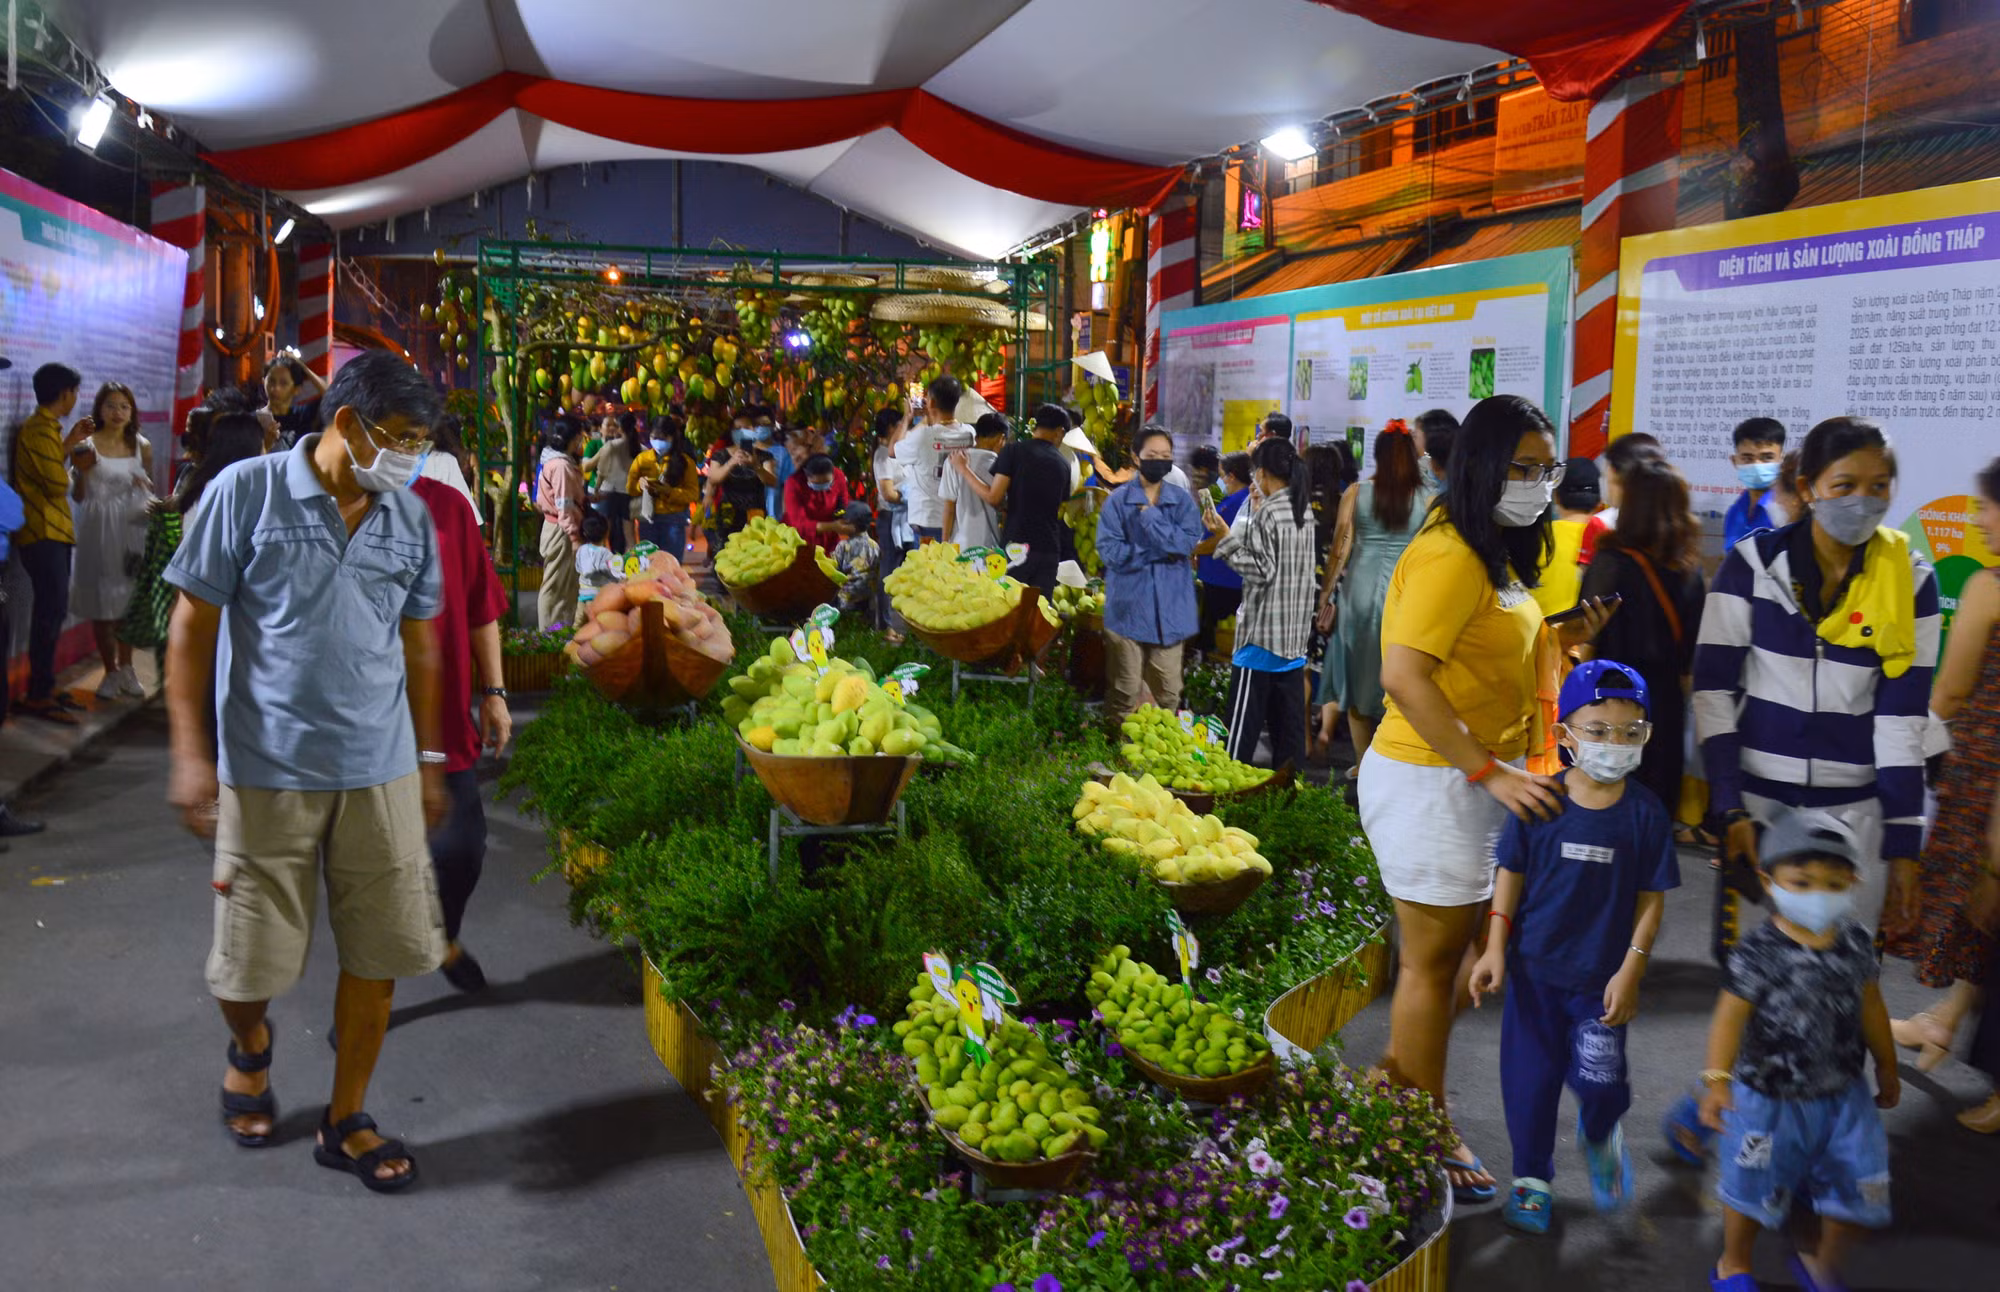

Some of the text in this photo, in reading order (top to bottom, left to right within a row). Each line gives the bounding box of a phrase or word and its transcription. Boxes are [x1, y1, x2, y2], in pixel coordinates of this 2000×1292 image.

[1718, 223, 1985, 280] DIỆN TÍCH VÀ SẢN LƯỢNG XOÀI ĐỒNG THÁP
[1927, 289, 1948, 304] Đồng
[1951, 287, 1971, 303] Tháp
[1939, 387, 1945, 400] 6
[1986, 403, 1992, 416] 2
[1918, 508, 1947, 521] GIỐNG
[1927, 526, 1964, 539] 1.117 ha
[1936, 542, 1951, 553] 9%
